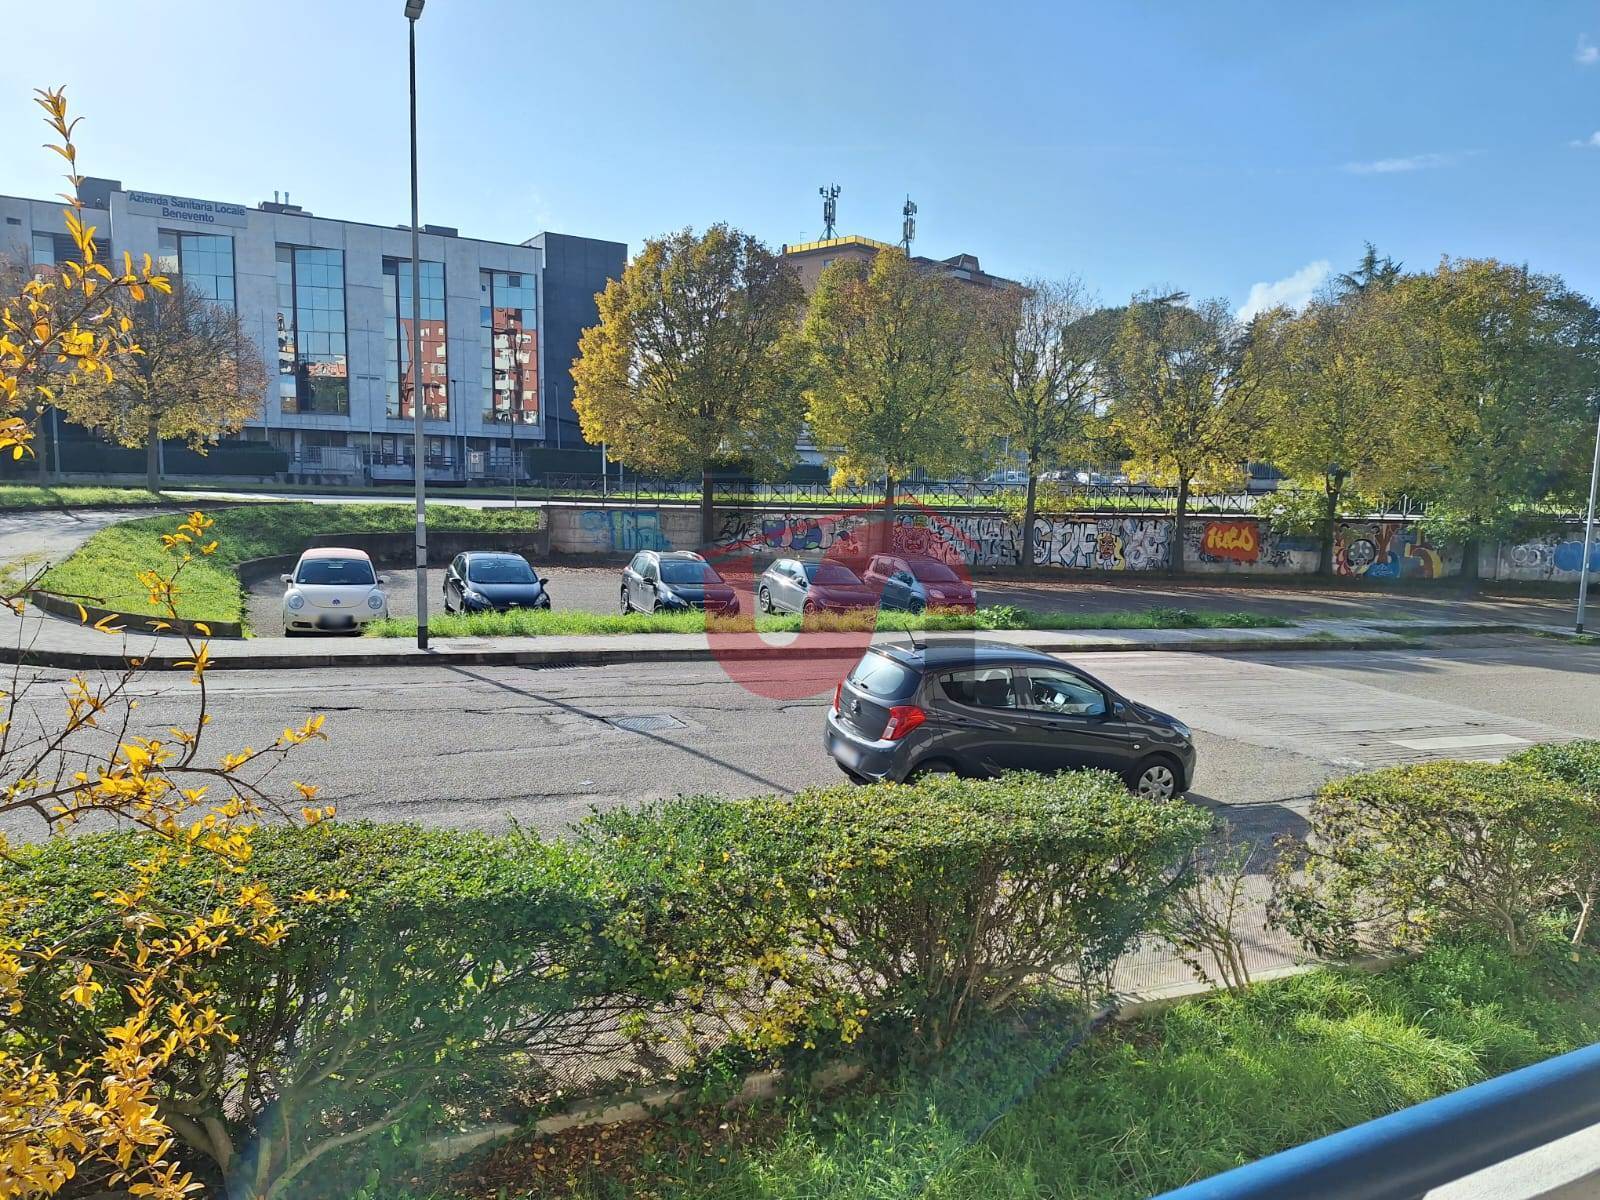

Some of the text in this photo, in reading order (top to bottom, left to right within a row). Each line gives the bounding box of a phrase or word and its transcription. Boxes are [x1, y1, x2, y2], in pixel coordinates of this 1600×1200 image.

[128, 192, 246, 216] Azienda Sanitaria Locale
[162, 207, 215, 222] Benevento
